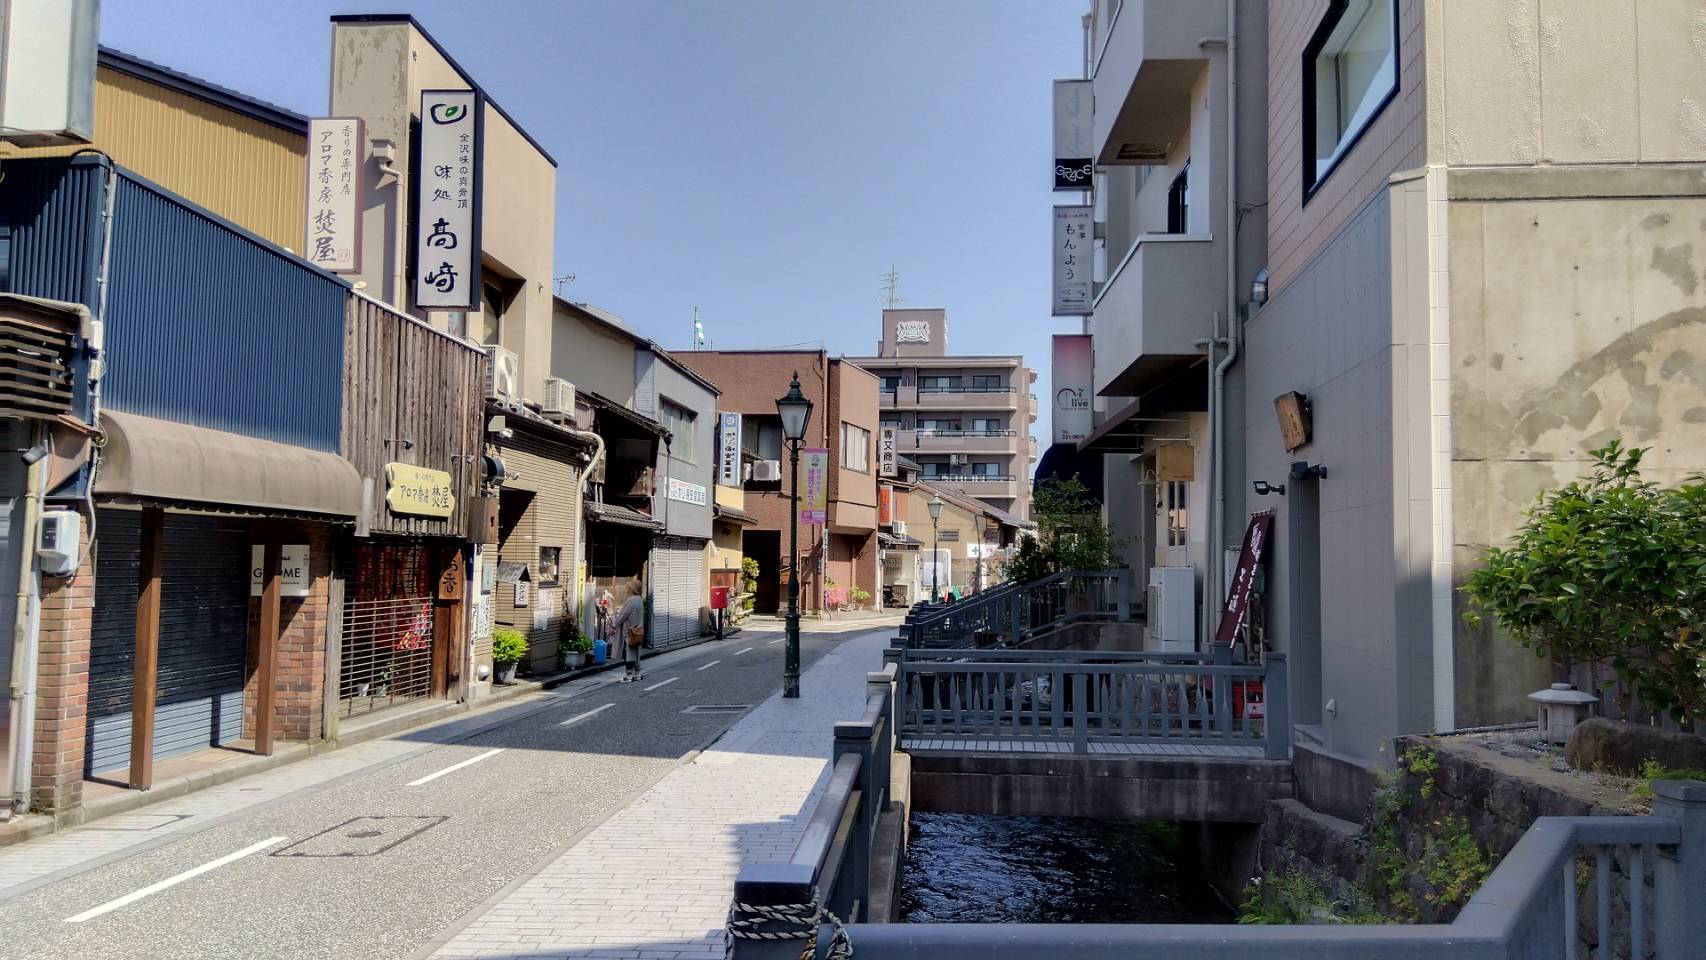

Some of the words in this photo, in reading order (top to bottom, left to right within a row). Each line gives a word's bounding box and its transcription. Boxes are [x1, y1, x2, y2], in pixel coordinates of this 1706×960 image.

[341, 125, 351, 195] 香りの専門店
[457, 132, 470, 209] 金沢味の真骨頂
[1055, 164, 1092, 182] GRACE
[1064, 223, 1077, 280] もんよう
